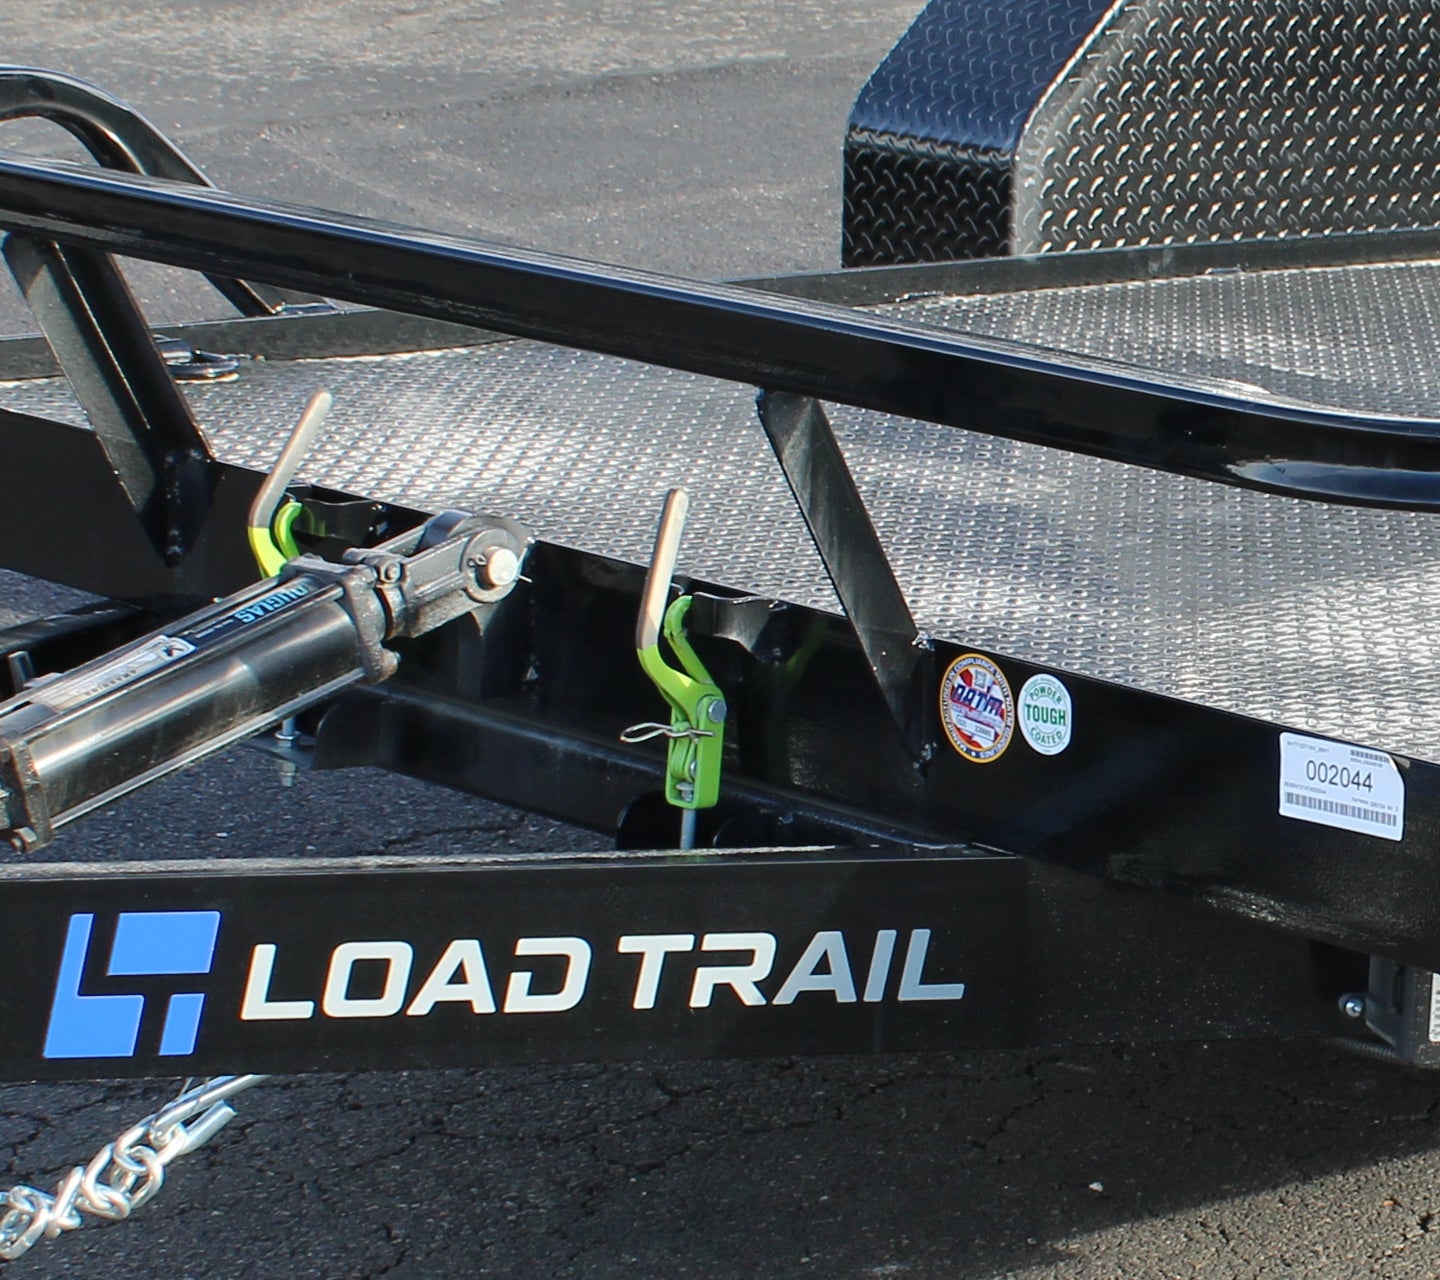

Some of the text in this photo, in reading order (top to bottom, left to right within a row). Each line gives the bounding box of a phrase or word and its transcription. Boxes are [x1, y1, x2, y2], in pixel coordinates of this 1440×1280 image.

[1029, 686, 1062, 705] POWDER
[1025, 703, 1067, 727] TOUGH
[1030, 727, 1062, 745] COATED
[1306, 759, 1373, 793] 002044
[239, 928, 966, 1022] LOAD TRAIL
